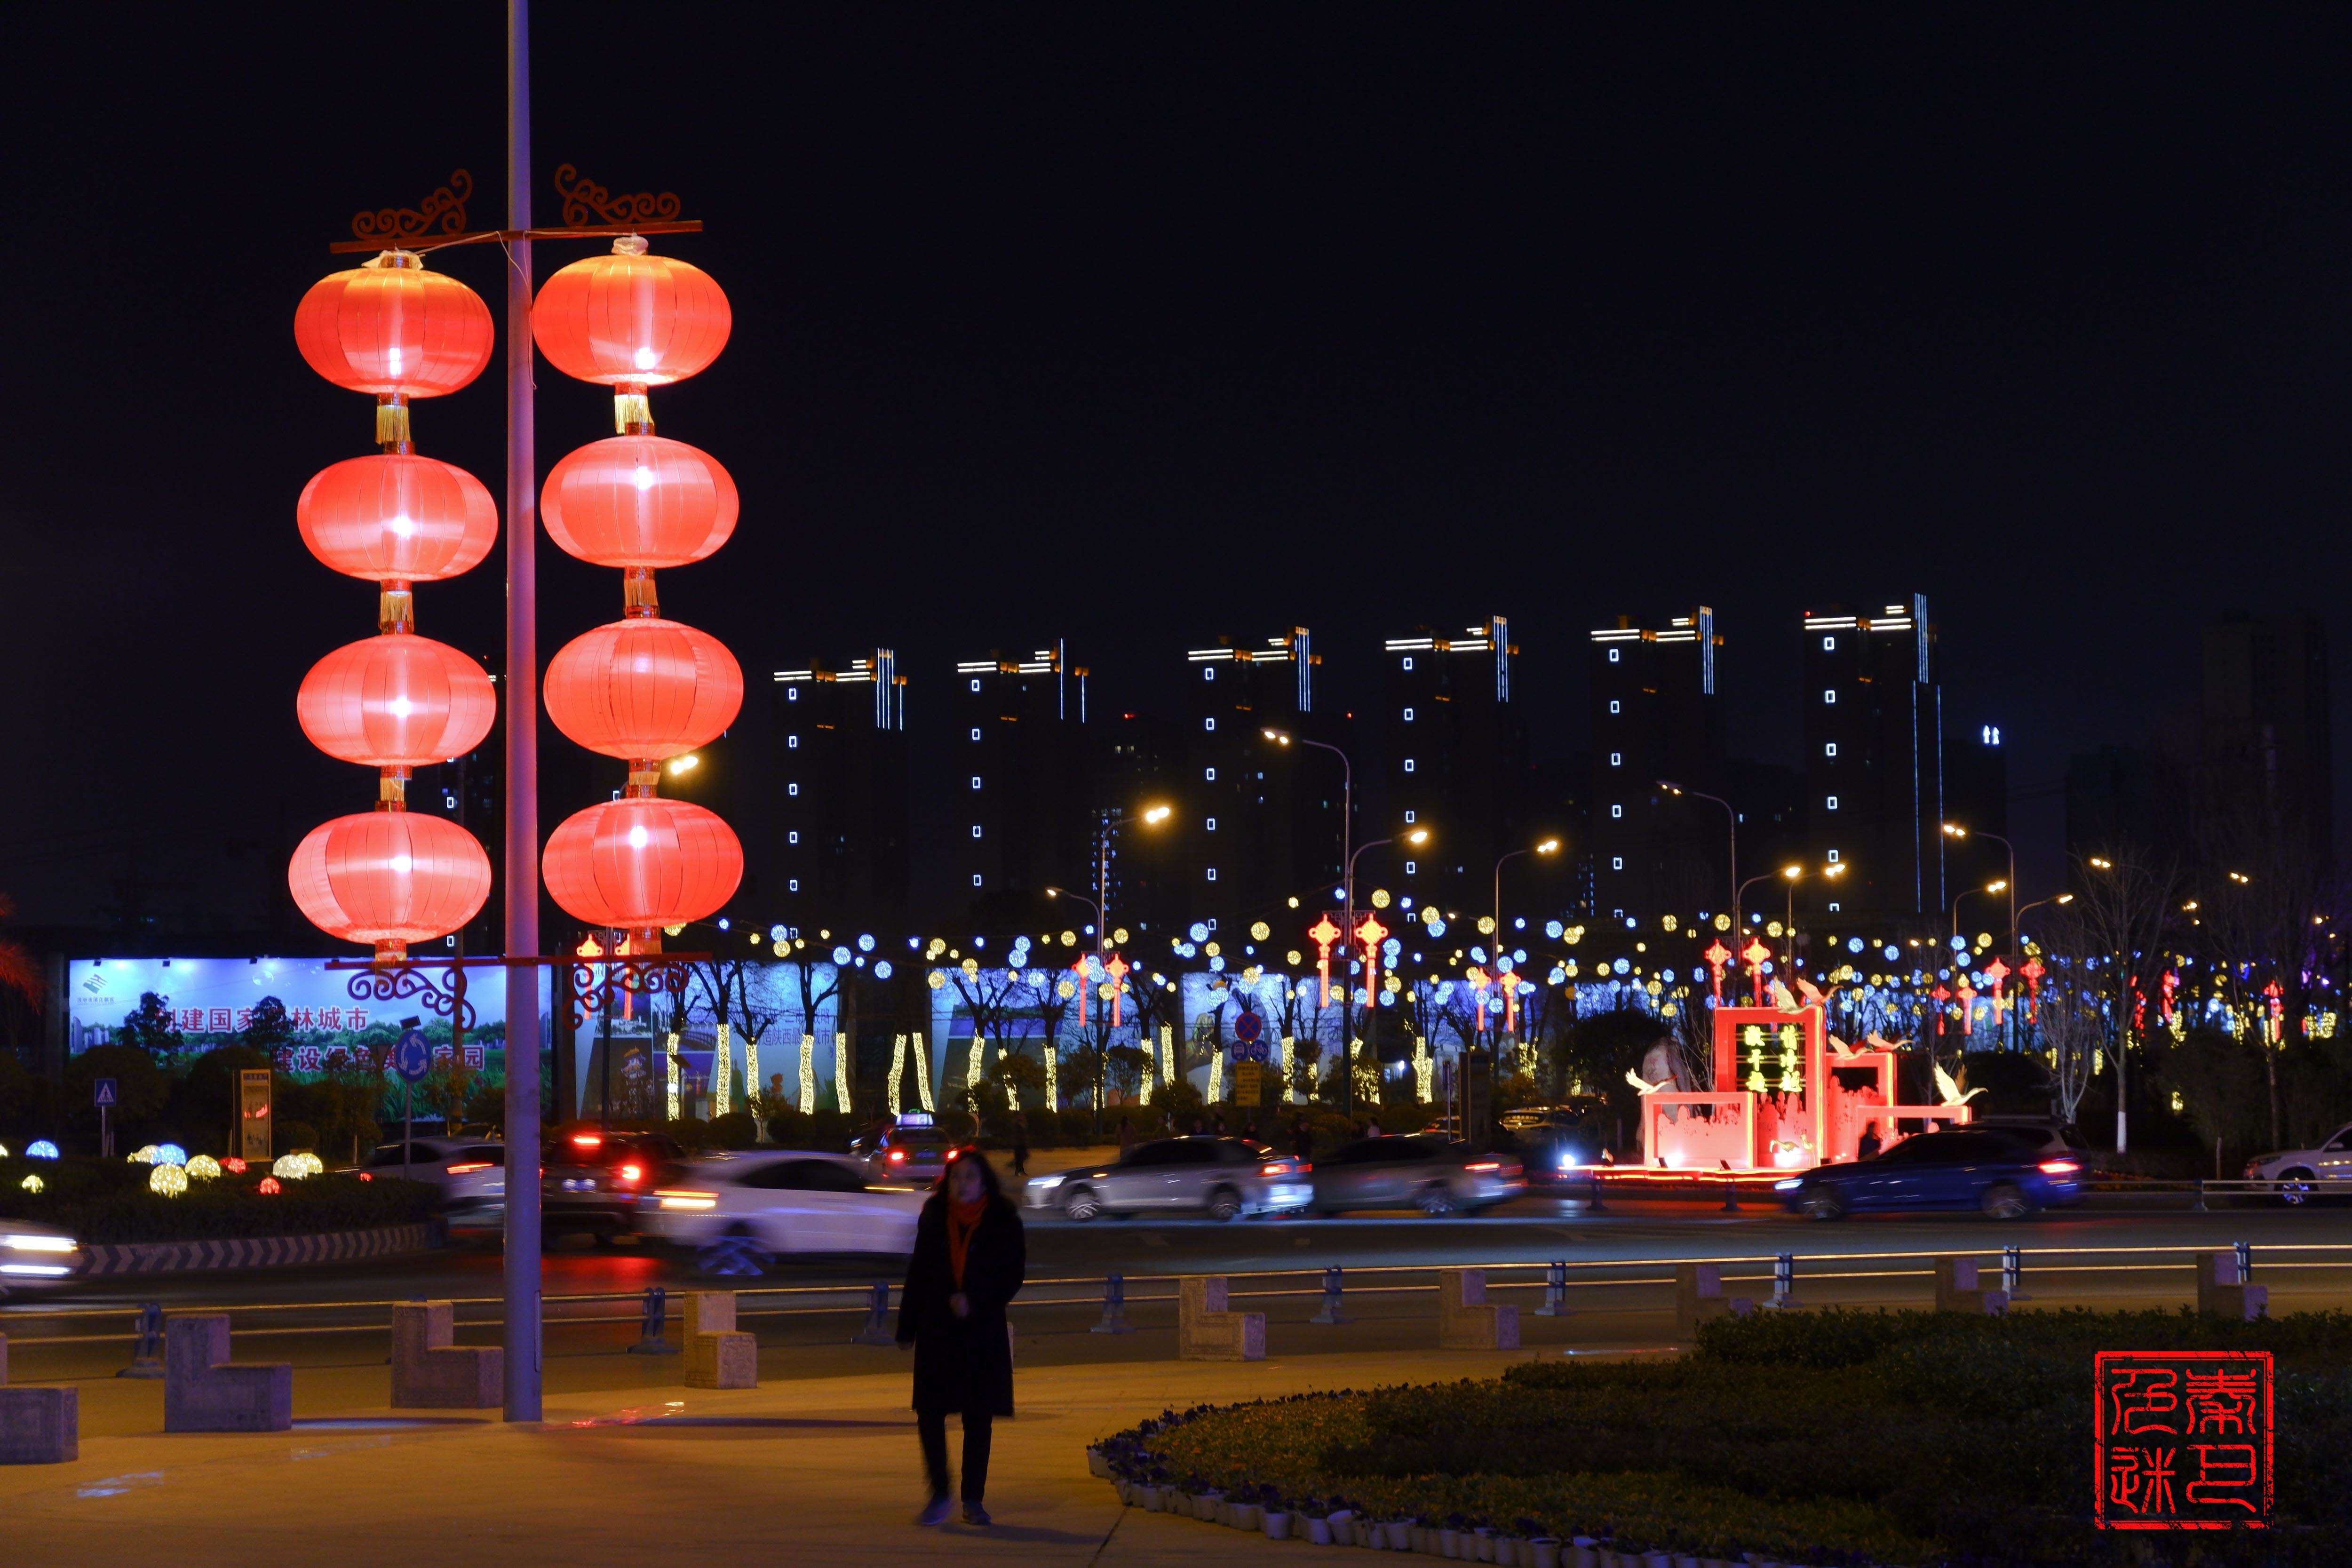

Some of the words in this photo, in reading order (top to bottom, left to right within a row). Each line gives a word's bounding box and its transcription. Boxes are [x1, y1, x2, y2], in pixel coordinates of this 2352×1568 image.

[154, 1007, 369, 1033] 创建国家林城市
